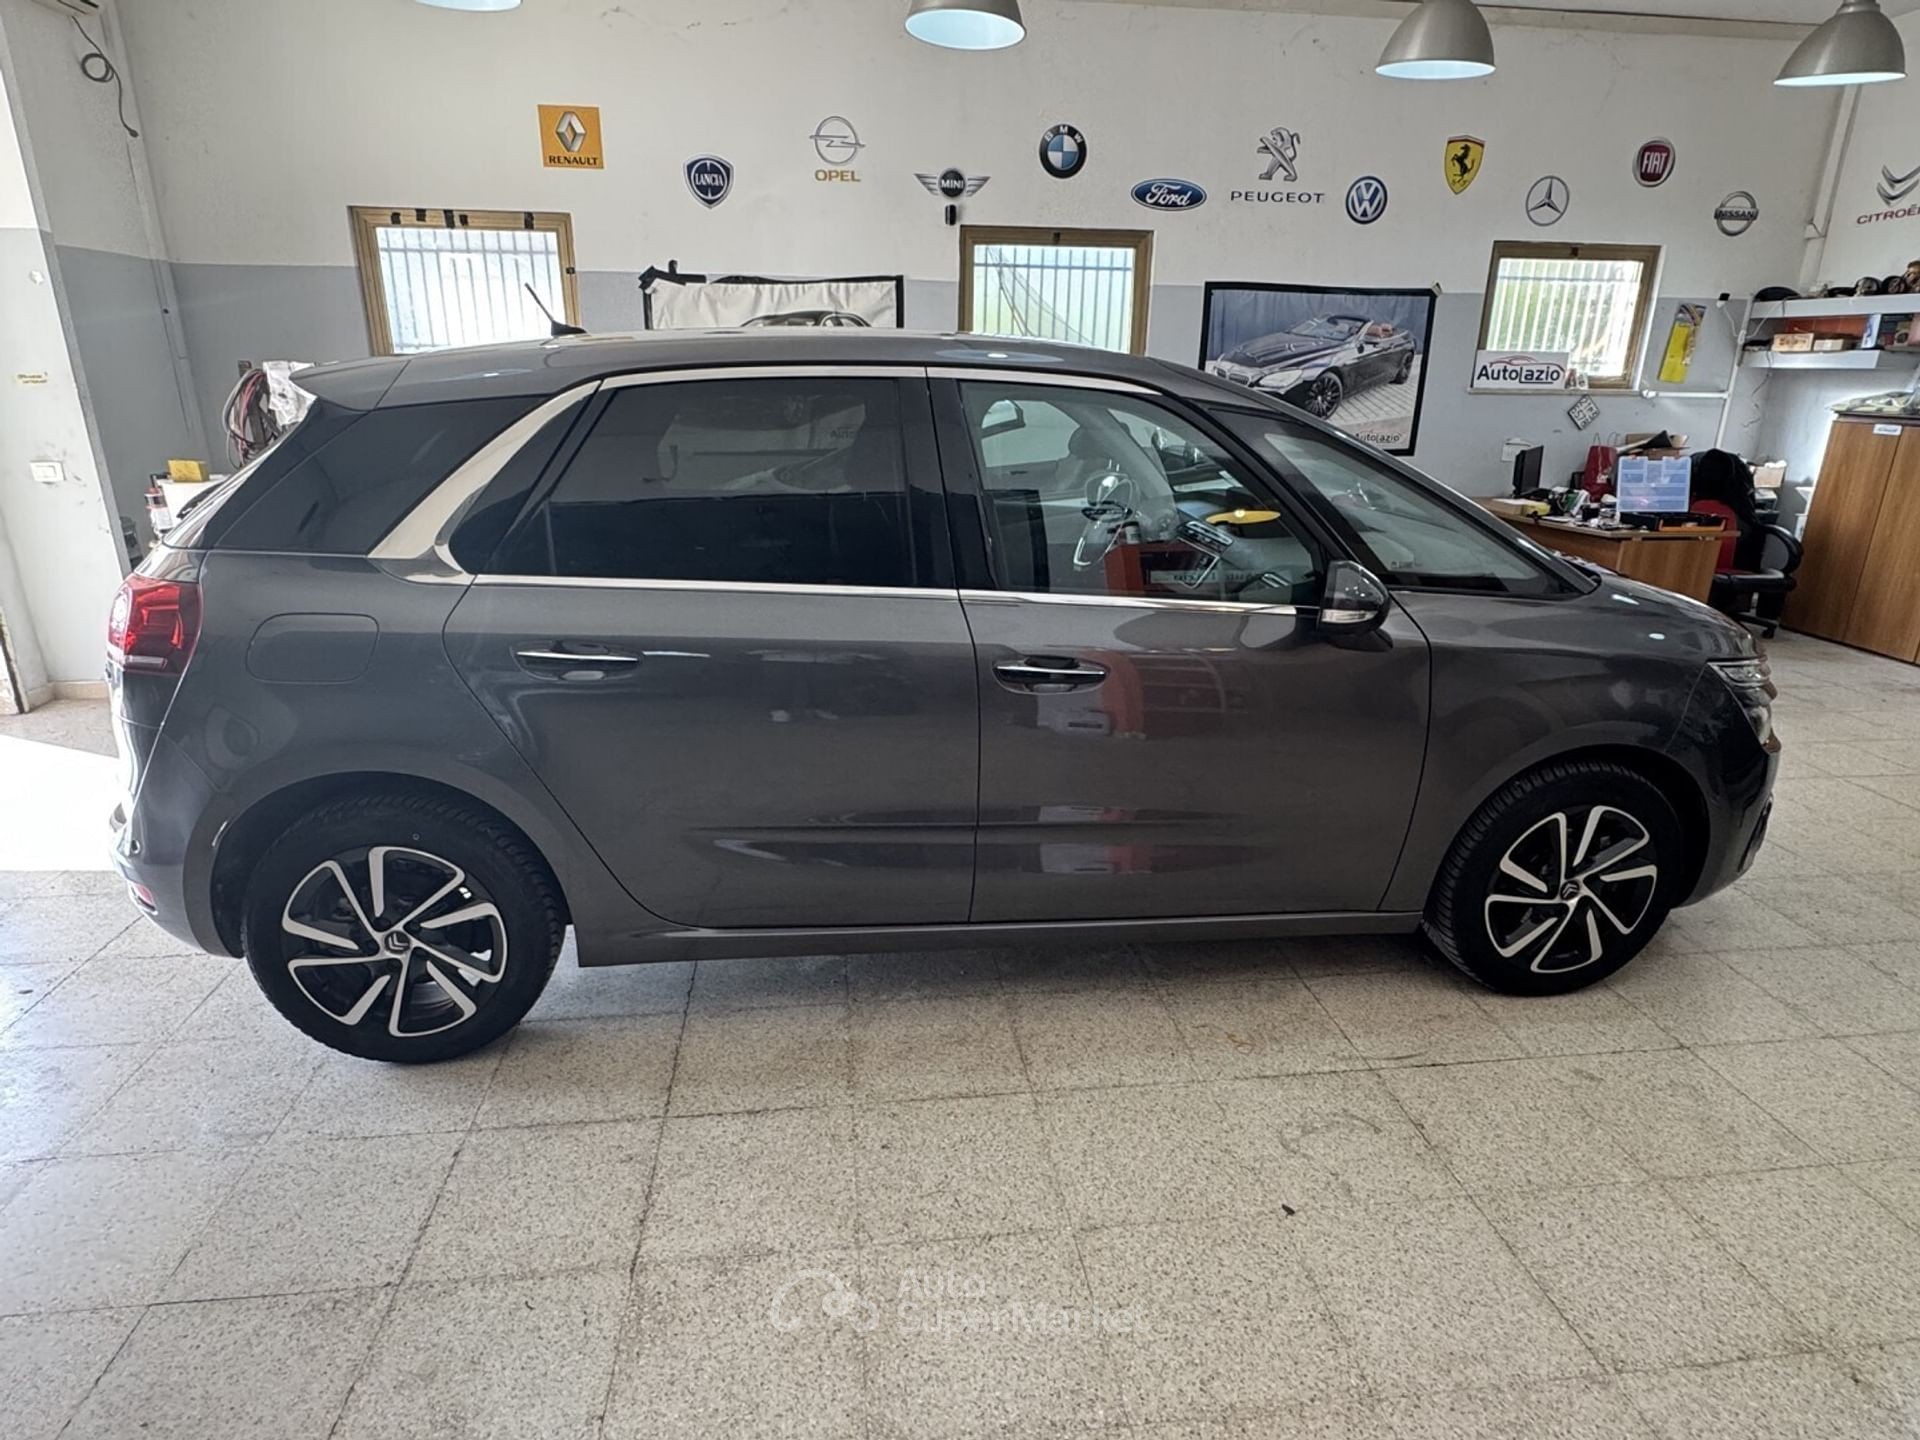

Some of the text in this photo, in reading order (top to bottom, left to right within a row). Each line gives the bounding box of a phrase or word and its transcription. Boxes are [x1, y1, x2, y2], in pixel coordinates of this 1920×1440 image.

[1044, 126, 1084, 144] BMW
[549, 155, 599, 166] RENAULT
[1641, 151, 1668, 175] FIAT
[694, 172, 724, 187] LANCIA
[815, 169, 862, 182] OPEL
[940, 179, 964, 190] MINI
[1145, 182, 1193, 207] Ford
[1230, 190, 1326, 204] PEUGEOT
[1718, 208, 1755, 219] NISSAN
[1856, 204, 1920, 225] CITROË
